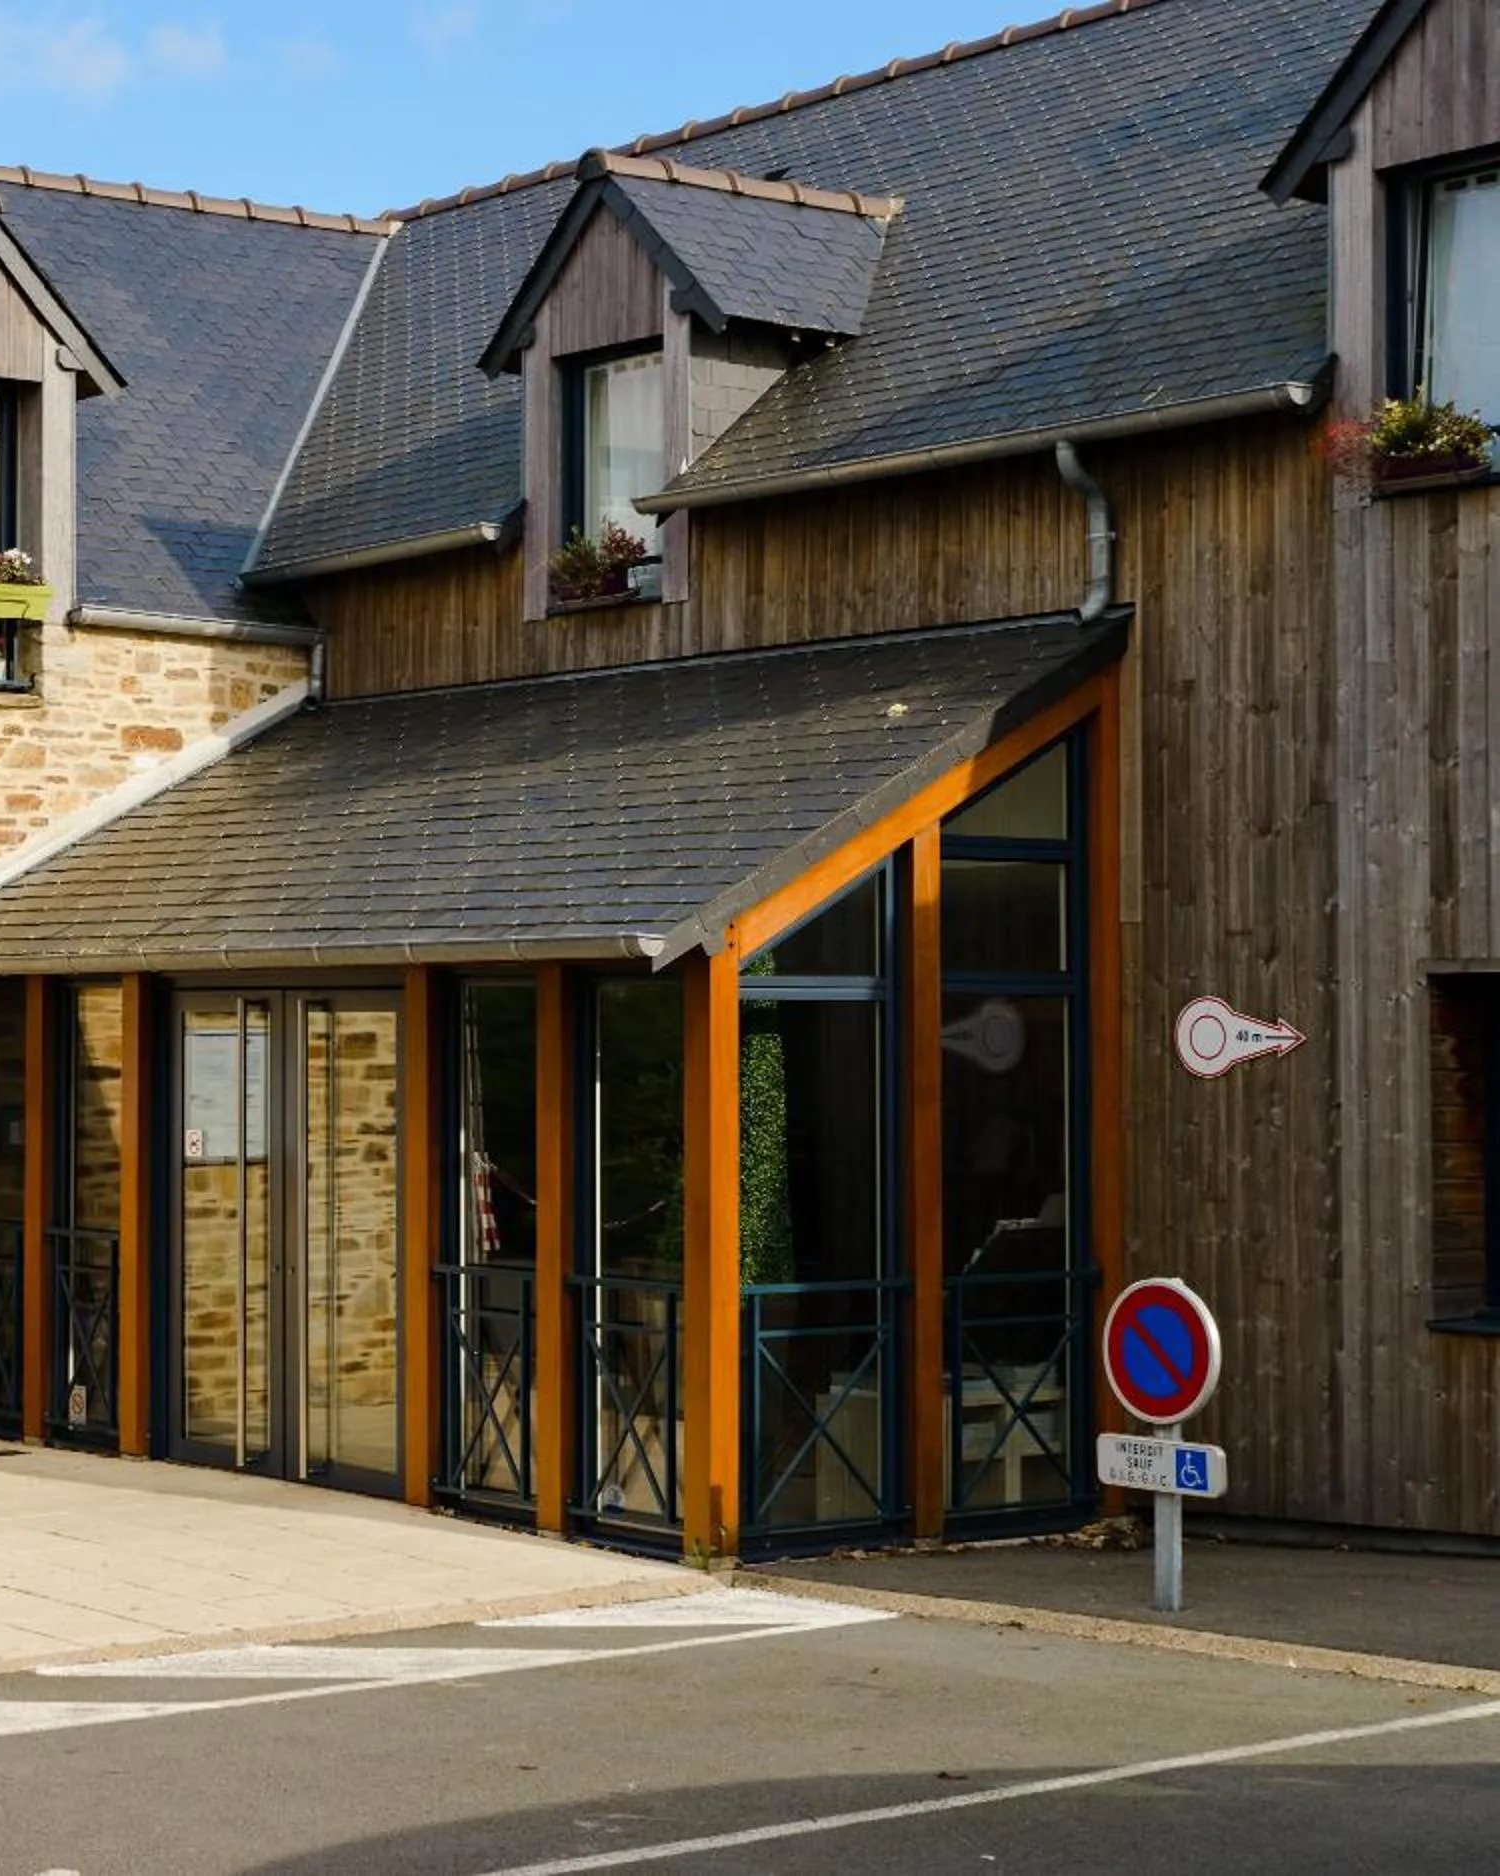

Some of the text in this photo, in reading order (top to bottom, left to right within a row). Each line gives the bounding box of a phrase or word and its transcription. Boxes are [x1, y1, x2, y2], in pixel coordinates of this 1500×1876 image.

[1251, 1033, 1263, 1043] m
[1115, 1442, 1163, 1457] INTERDIT
[1126, 1456, 1153, 1469] SAUF
